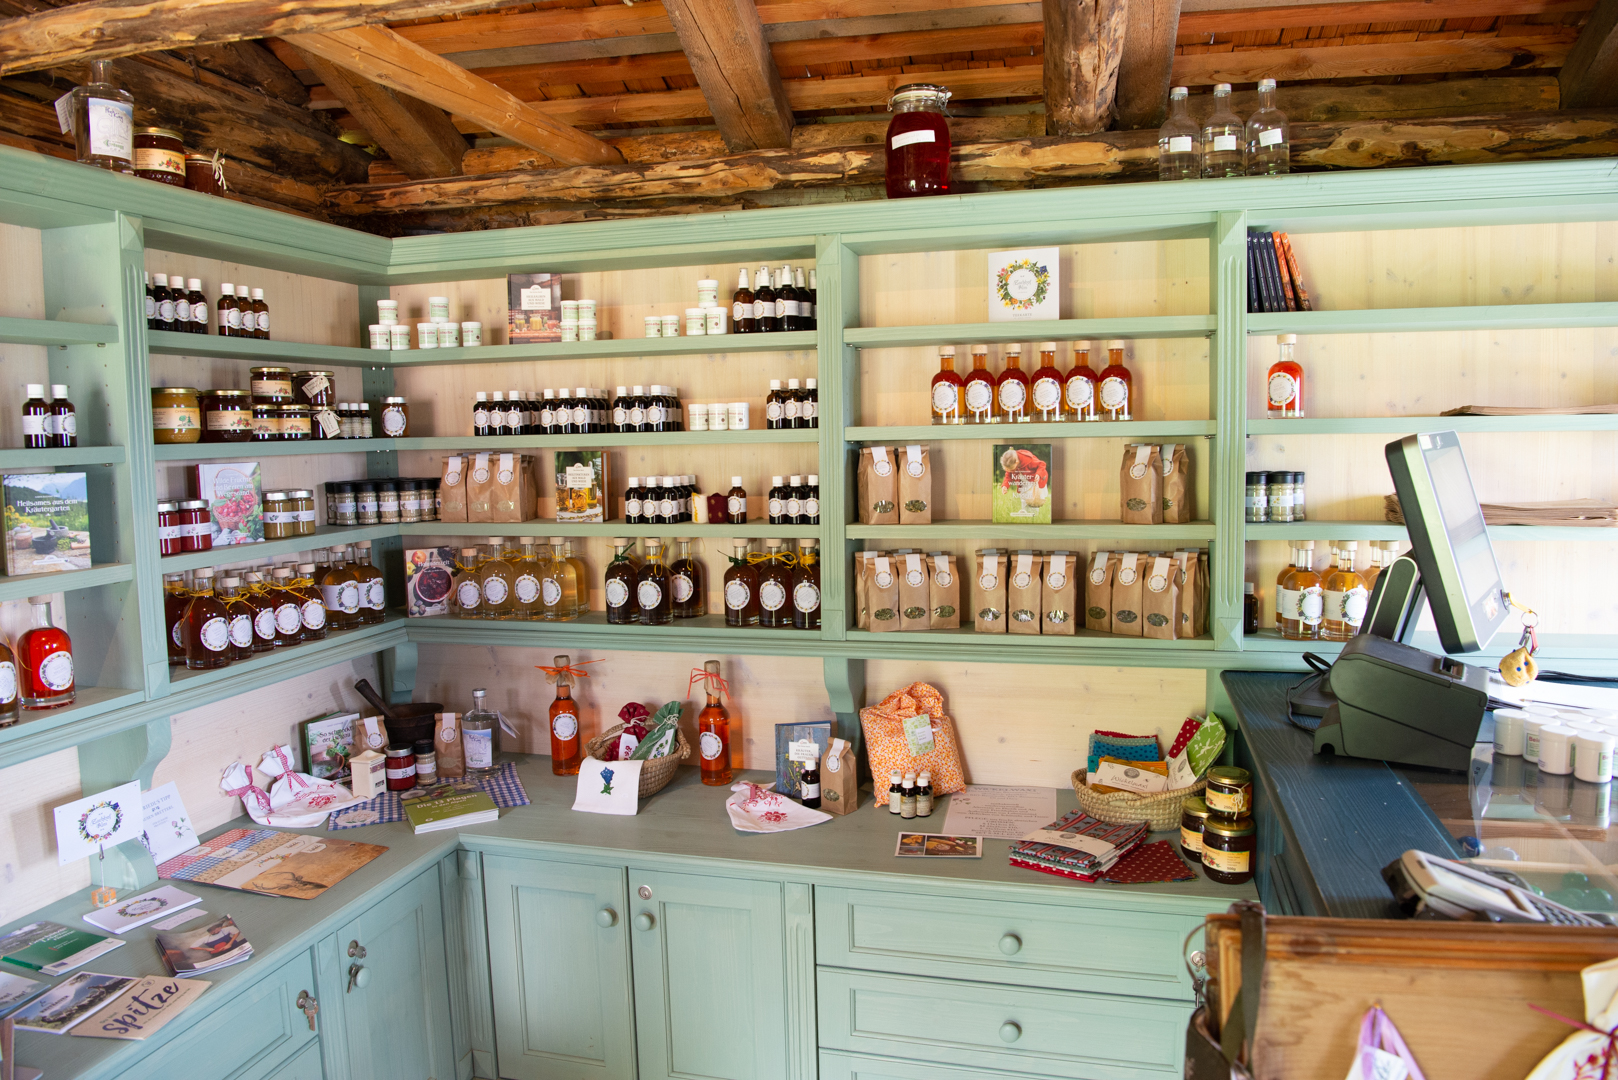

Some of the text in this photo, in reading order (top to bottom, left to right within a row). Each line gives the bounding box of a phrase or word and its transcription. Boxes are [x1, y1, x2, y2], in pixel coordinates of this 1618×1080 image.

[25, 505, 71, 513] Kräutergarten
[446, 794, 478, 803] Plagen
[102, 981, 179, 1035] spitze
